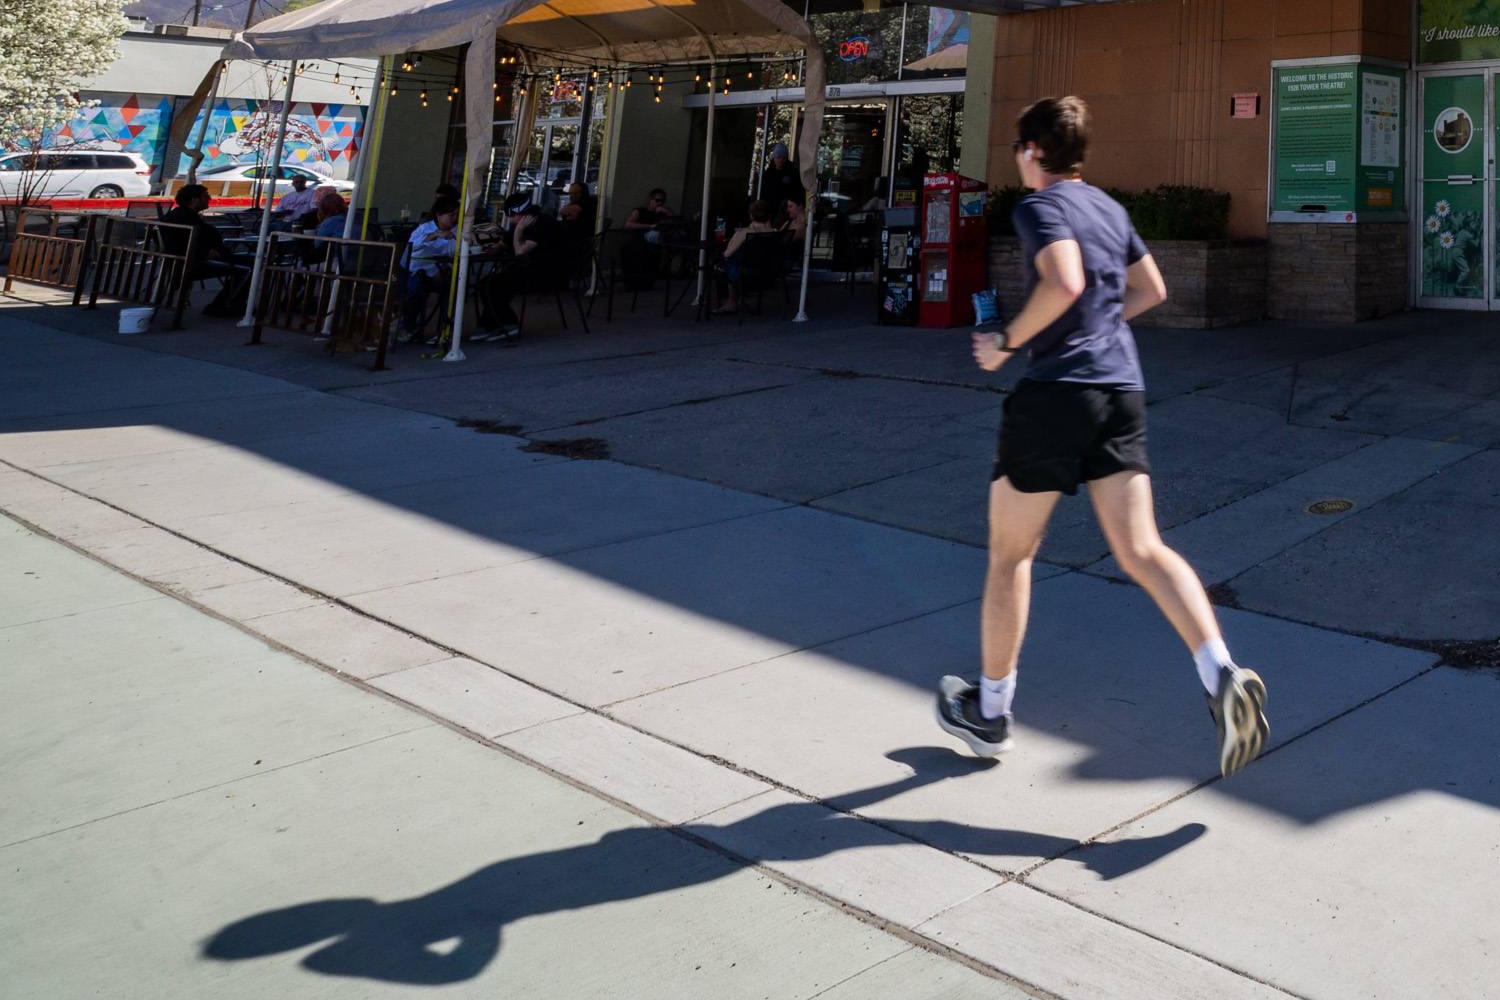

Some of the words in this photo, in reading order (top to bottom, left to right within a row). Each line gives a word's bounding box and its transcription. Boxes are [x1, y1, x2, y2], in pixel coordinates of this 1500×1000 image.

[1436, 26, 1476, 40] should
[1477, 24, 1497, 38] like
[840, 42, 868, 56] OPEN
[1320, 82, 1346, 90] THEATRE!
[829, 88, 841, 96] 878
